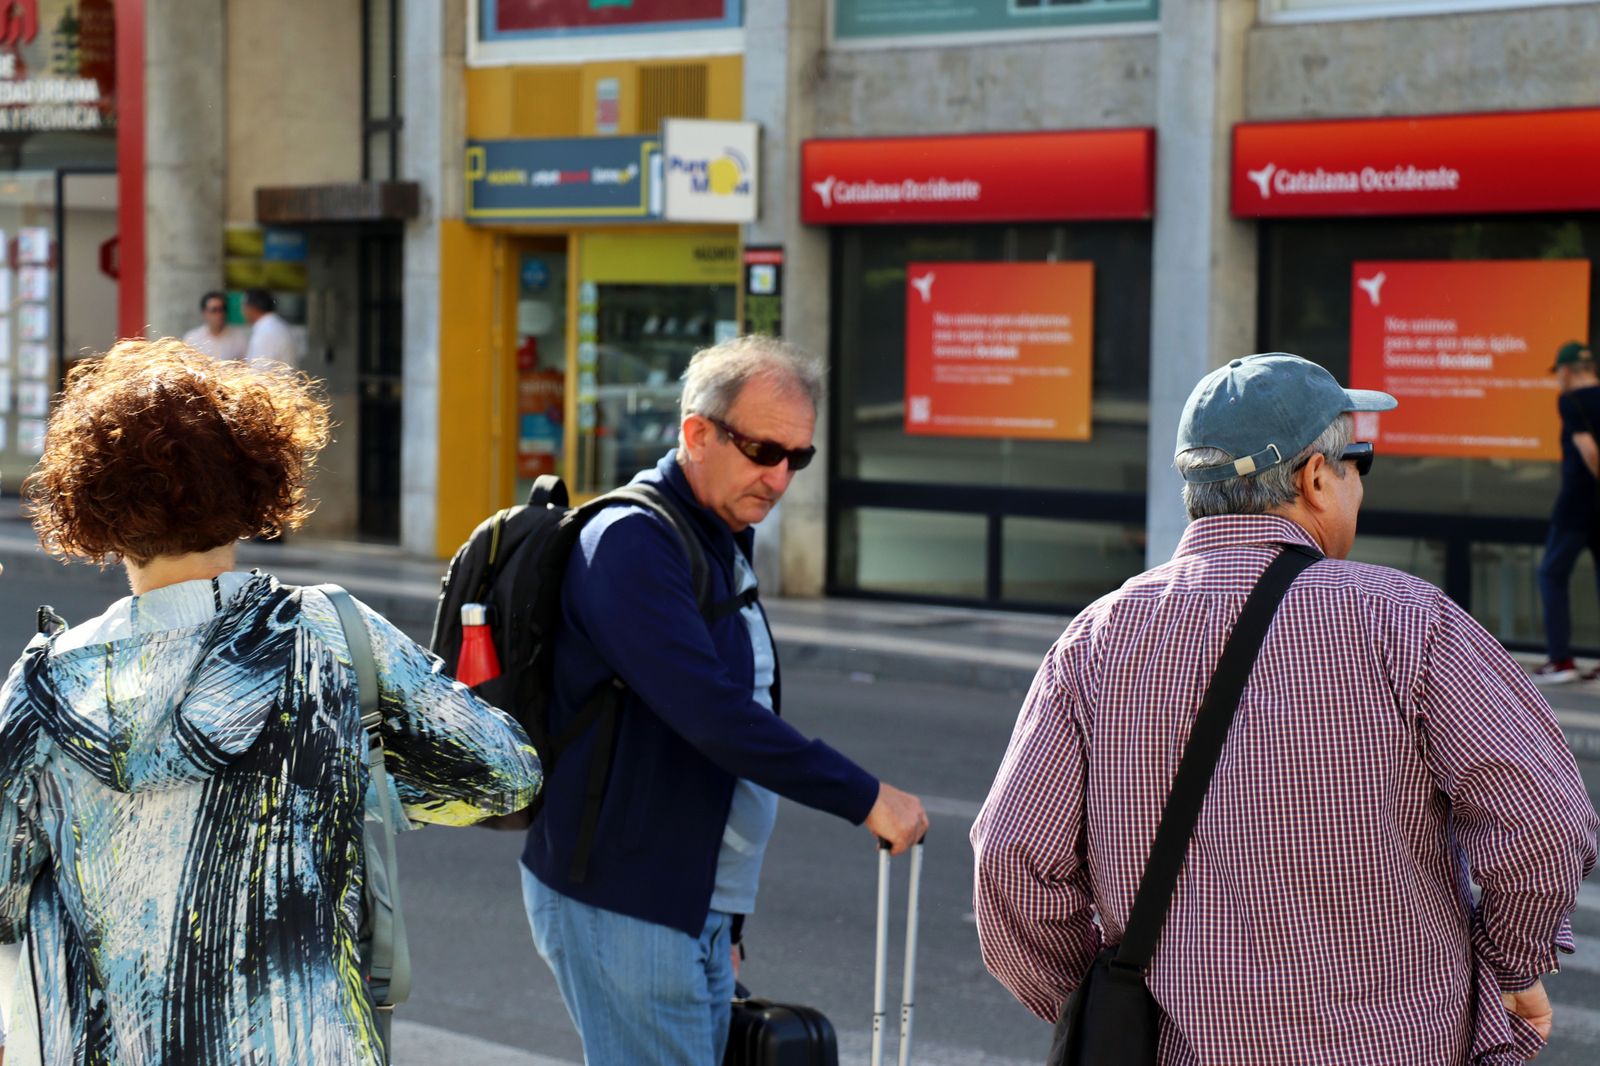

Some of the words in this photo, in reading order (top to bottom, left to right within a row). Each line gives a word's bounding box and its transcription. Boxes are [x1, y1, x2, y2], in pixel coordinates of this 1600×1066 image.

[35, 78, 100, 101] URBANA
[24, 106, 102, 129] PROVINCIA
[834, 180, 900, 203] Catalana
[901, 177, 981, 201] Occidente
[1274, 168, 1359, 194] Catalana
[1361, 165, 1460, 191] Occidente
